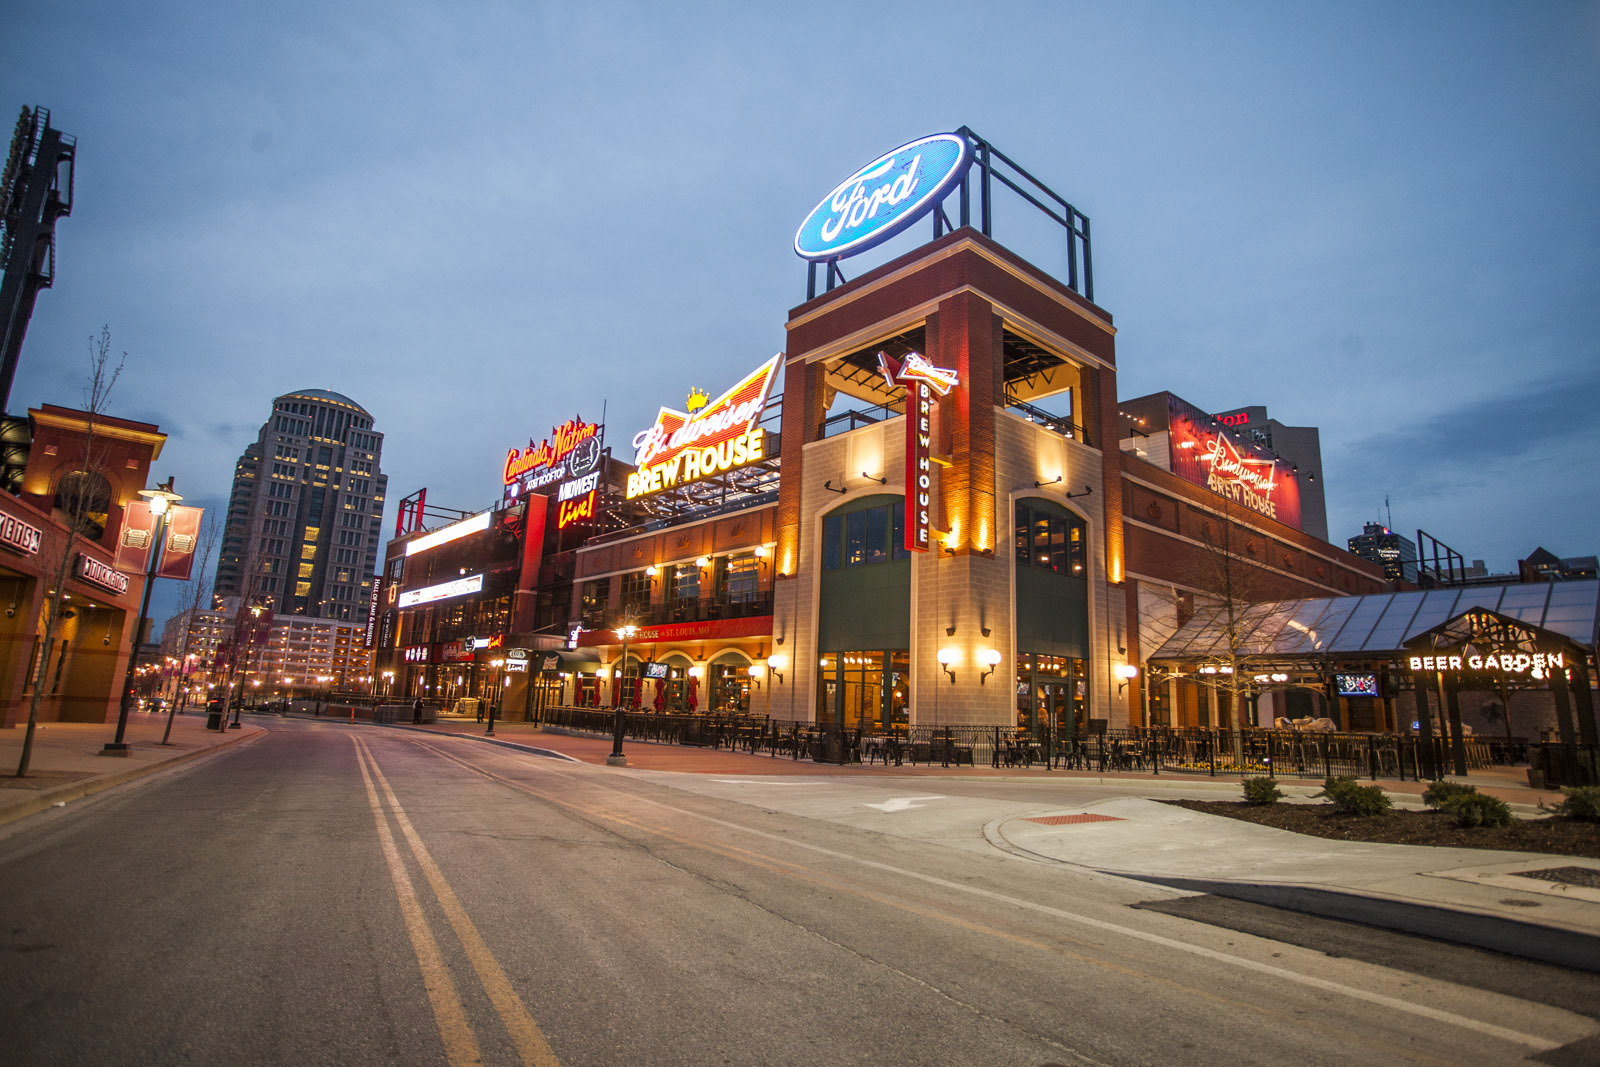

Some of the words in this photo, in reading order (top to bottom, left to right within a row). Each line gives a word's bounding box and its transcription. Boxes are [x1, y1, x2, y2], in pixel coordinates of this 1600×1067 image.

[821, 153, 922, 243] Ford
[632, 398, 766, 466] Budweiser
[918, 384, 930, 449] BREW
[503, 448, 551, 485] Cardinals
[546, 420, 597, 468] Nation
[539, 467, 567, 488] ROOFTOP
[626, 455, 683, 500] BREW
[683, 427, 765, 483] HOUSE
[1206, 440, 1275, 491] Budweiser
[558, 471, 600, 502] MIDWEST
[558, 490, 596, 528] Live!
[918, 456, 930, 543] HOUSE
[1208, 473, 1241, 502] BREW
[1243, 488, 1277, 520] HOUSE
[90, 561, 125, 591] TICKETS
[1409, 656, 1463, 672] BEER
[1467, 652, 1565, 673] GARDEN
